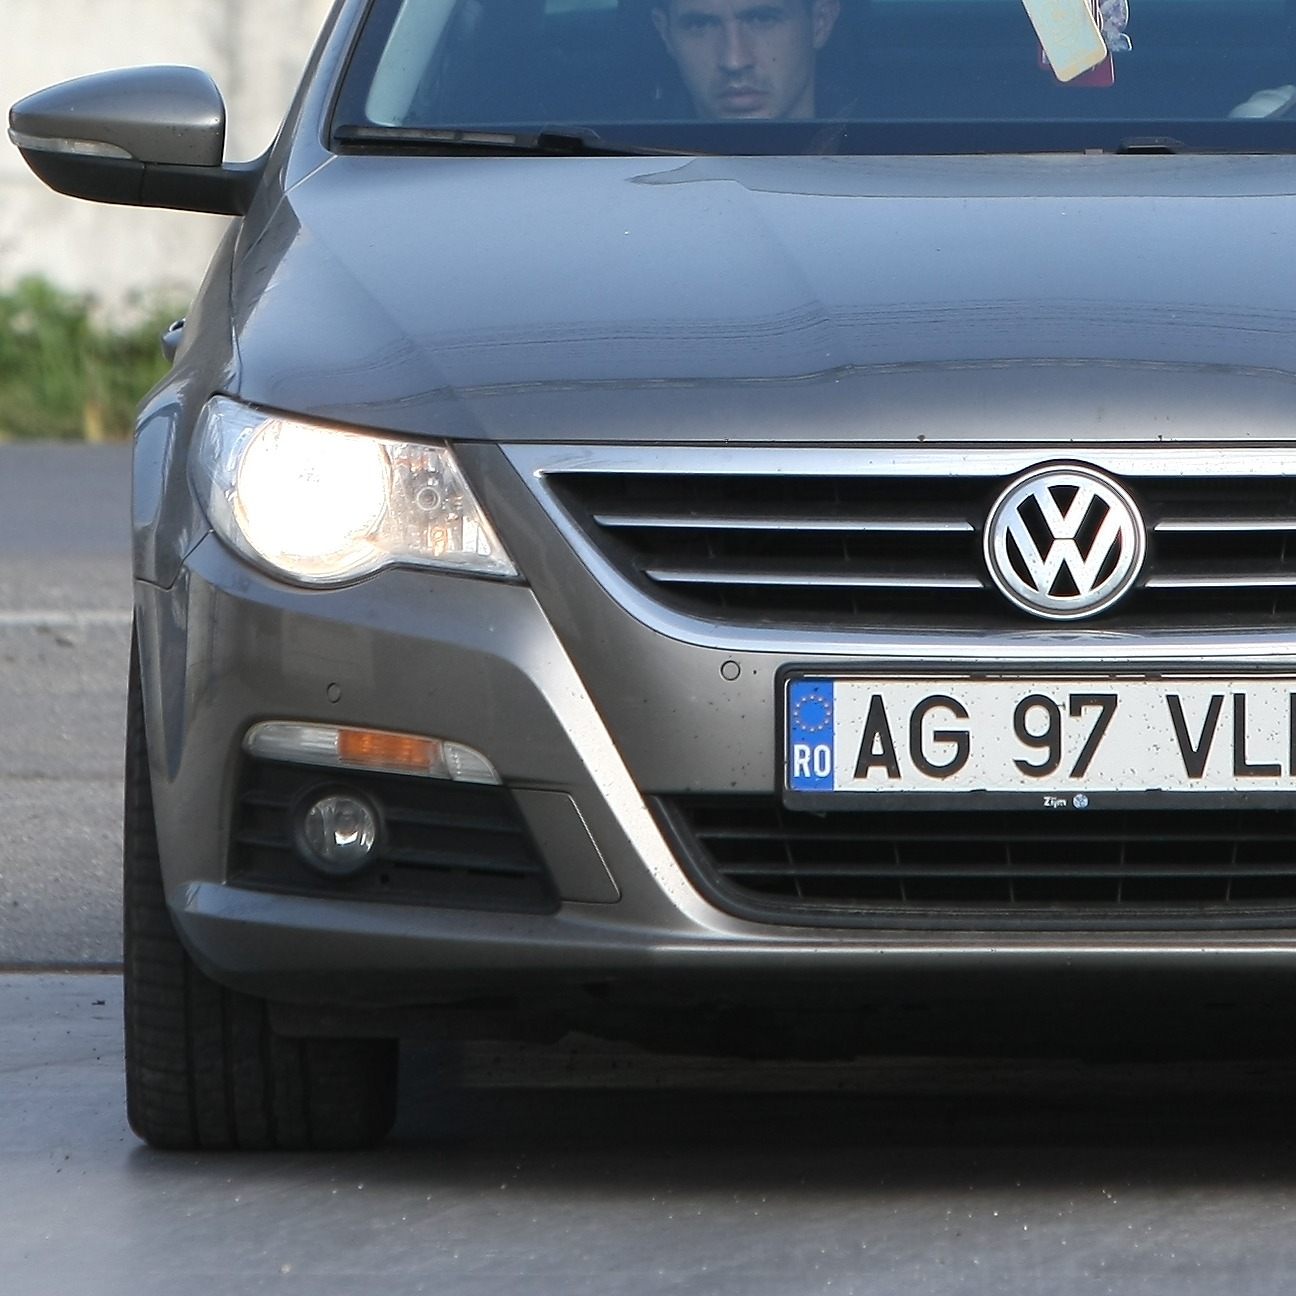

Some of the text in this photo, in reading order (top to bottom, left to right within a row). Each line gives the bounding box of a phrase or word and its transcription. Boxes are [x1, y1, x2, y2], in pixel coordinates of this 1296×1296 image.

[996, 475, 1133, 608] VW
[793, 744, 831, 778] RO
[853, 694, 971, 779] AG
[1013, 693, 1118, 778] 97
